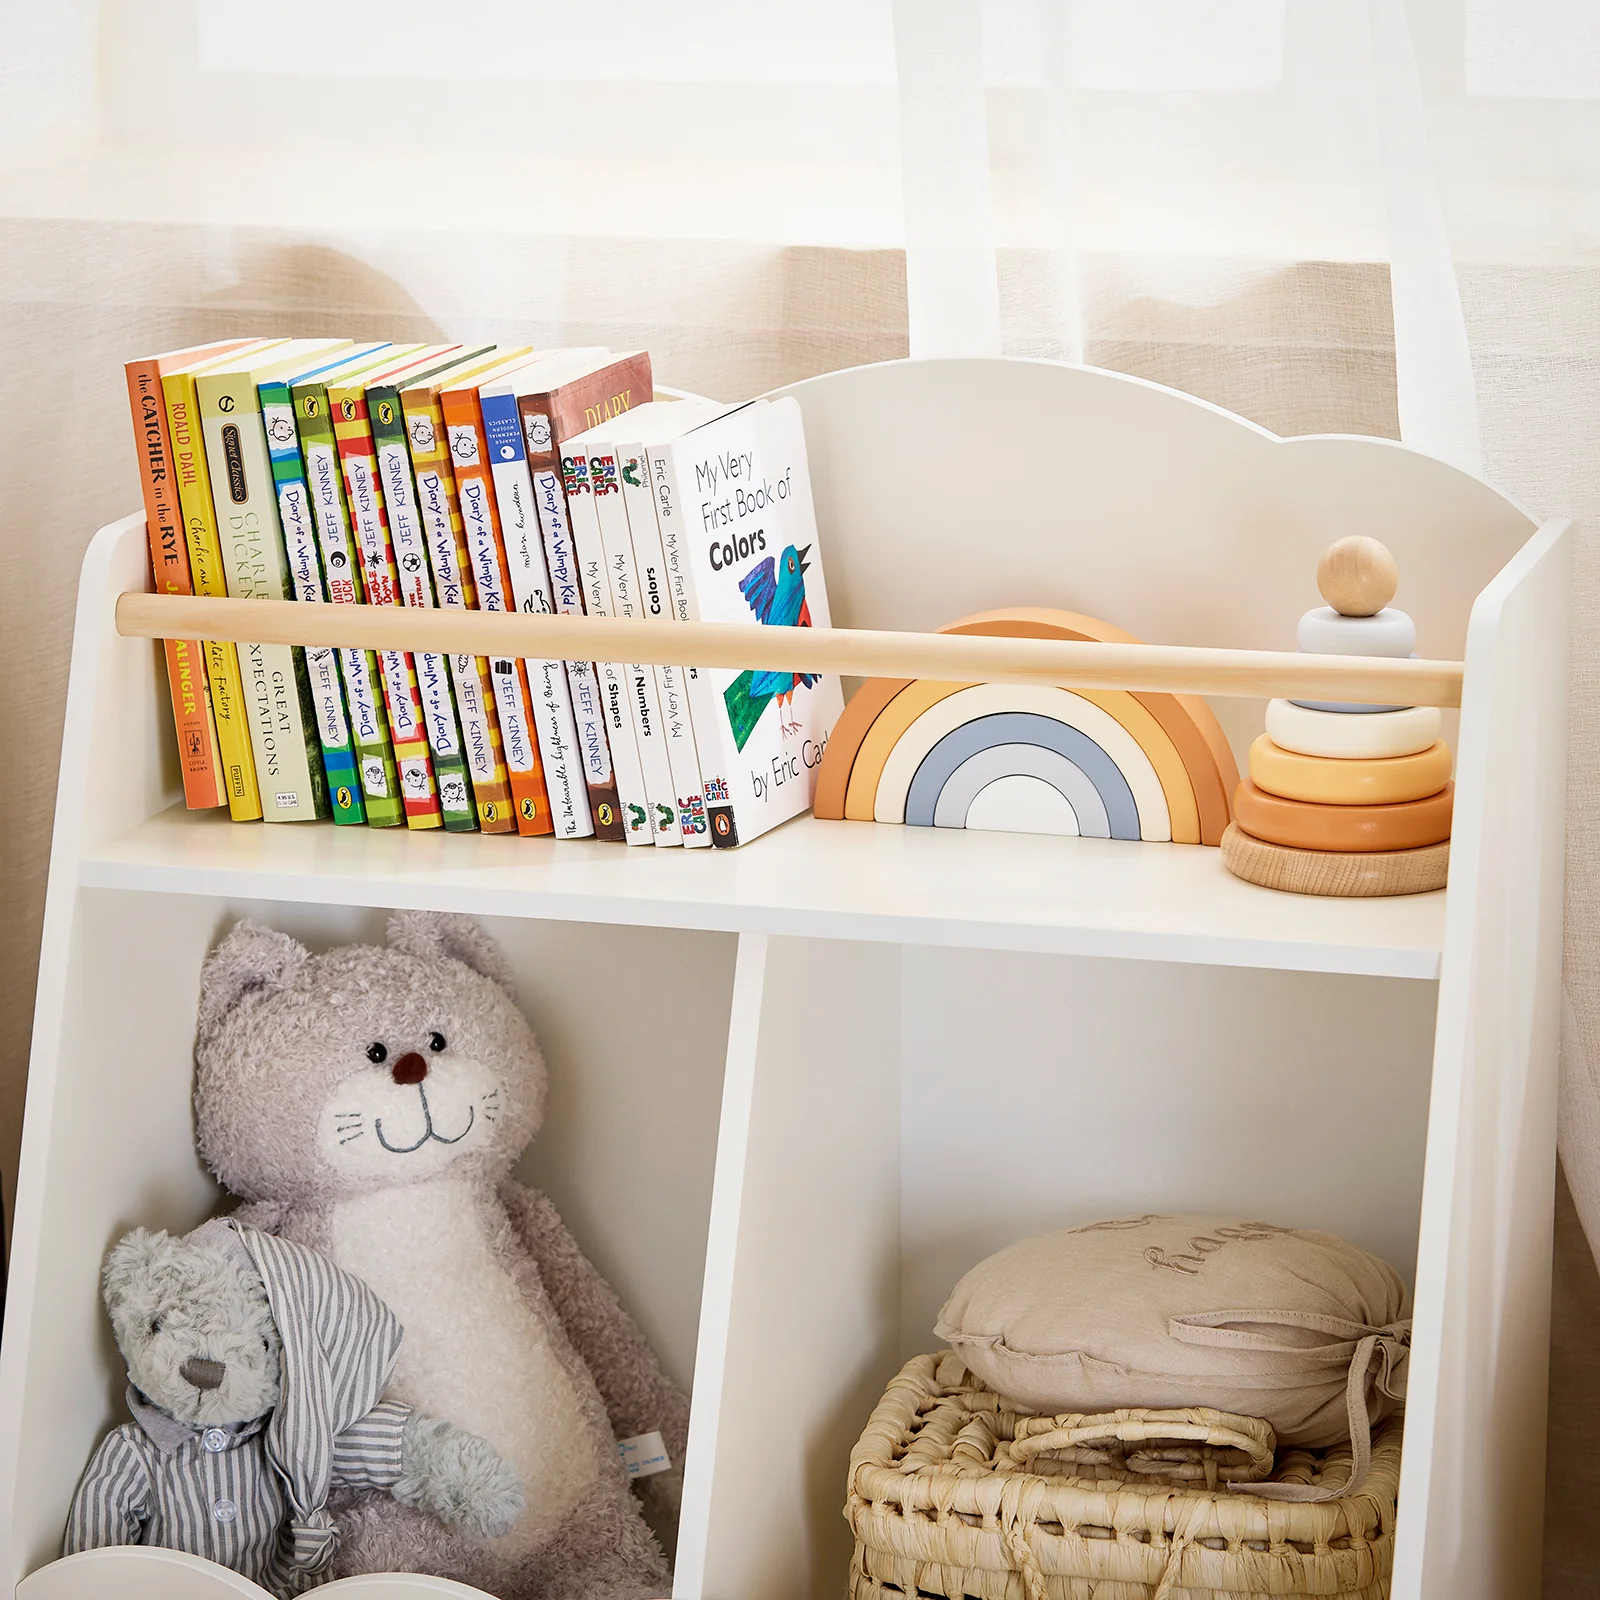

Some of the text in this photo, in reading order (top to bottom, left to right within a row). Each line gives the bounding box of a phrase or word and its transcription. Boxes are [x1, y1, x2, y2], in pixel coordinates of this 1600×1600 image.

[489, 418, 516, 427] CLASSICS
[584, 390, 631, 429] DIARY
[171, 402, 197, 487] ROALD DAHL
[489, 431, 520, 440] PERENNIAL
[138, 374, 179, 566] the CATCHER in the RYE
[225, 428, 244, 500] Signet Classics
[562, 456, 581, 497] CARLE
[590, 456, 608, 497] CARLE
[695, 451, 752, 496] My Very
[286, 490, 303, 524] Diary
[316, 454, 340, 543] JEFF KINNEY
[353, 463, 377, 548] JEFF KINNEY
[387, 452, 413, 546] JEFF KINNEY
[423, 475, 442, 514] Diary
[465, 484, 484, 523] Diary
[540, 475, 559, 515] Diary
[654, 459, 673, 517] Eric Carle
[702, 467, 791, 533] First Book of
[296, 526, 305, 536] of
[435, 517, 445, 528] of
[476, 526, 487, 537] of
[551, 517, 562, 529] of
[189, 517, 210, 564] Charlie
[200, 568, 210, 586] and
[229, 516, 253, 598] DICKEN
[245, 512, 269, 599] CHARLE
[297, 545, 310, 582] Wimpy
[436, 539, 452, 582] Wimpy
[478, 547, 493, 590] Wimpy
[519, 532, 531, 568] milan
[553, 540, 568, 583] Wimpy
[586, 561, 599, 579] My
[709, 529, 766, 571] Colors
[302, 584, 316, 602] Kid
[342, 579, 356, 604] UCK
[381, 575, 393, 604] DOWN
[415, 576, 424, 600] STRAW
[443, 584, 459, 605] Kid
[560, 585, 575, 606] Kid
[591, 580, 602, 609] Very
[613, 554, 634, 618] My Very Fir
[646, 567, 661, 615] Colors
[666, 533, 690, 621] My Very First Boo
[409, 592, 417, 607] THE
[485, 591, 500, 612] Kid
[175, 640, 196, 715] ALINGER
[349, 648, 363, 678] Wim
[423, 653, 439, 688] Wimp
[605, 669, 617, 681] of
[213, 676, 231, 725] Factory
[272, 671, 291, 734] GREAT
[318, 663, 339, 742] JEFF KINNEY
[354, 688, 364, 698] of
[392, 681, 402, 691] of
[429, 699, 440, 710] of
[608, 683, 622, 729] Shapes
[632, 663, 651, 737] of Numbers
[662, 665, 683, 738] My Very First
[249, 644, 279, 776] XPECTATIONS
[360, 700, 374, 737] Diary
[395, 693, 412, 728] Diary
[462, 681, 488, 774] JEFF KINNEY
[501, 677, 525, 766] JEFF KINNEY
[578, 683, 604, 776] JEFF KINNEY
[433, 713, 452, 751] Diary
[543, 661, 577, 835] The Unbearable Lightness of Being
[232, 767, 243, 795] PUFFIN
[751, 730, 828, 803] by Eric Car
[690, 795, 707, 834] CARLE
[705, 791, 730, 801] CARLE
